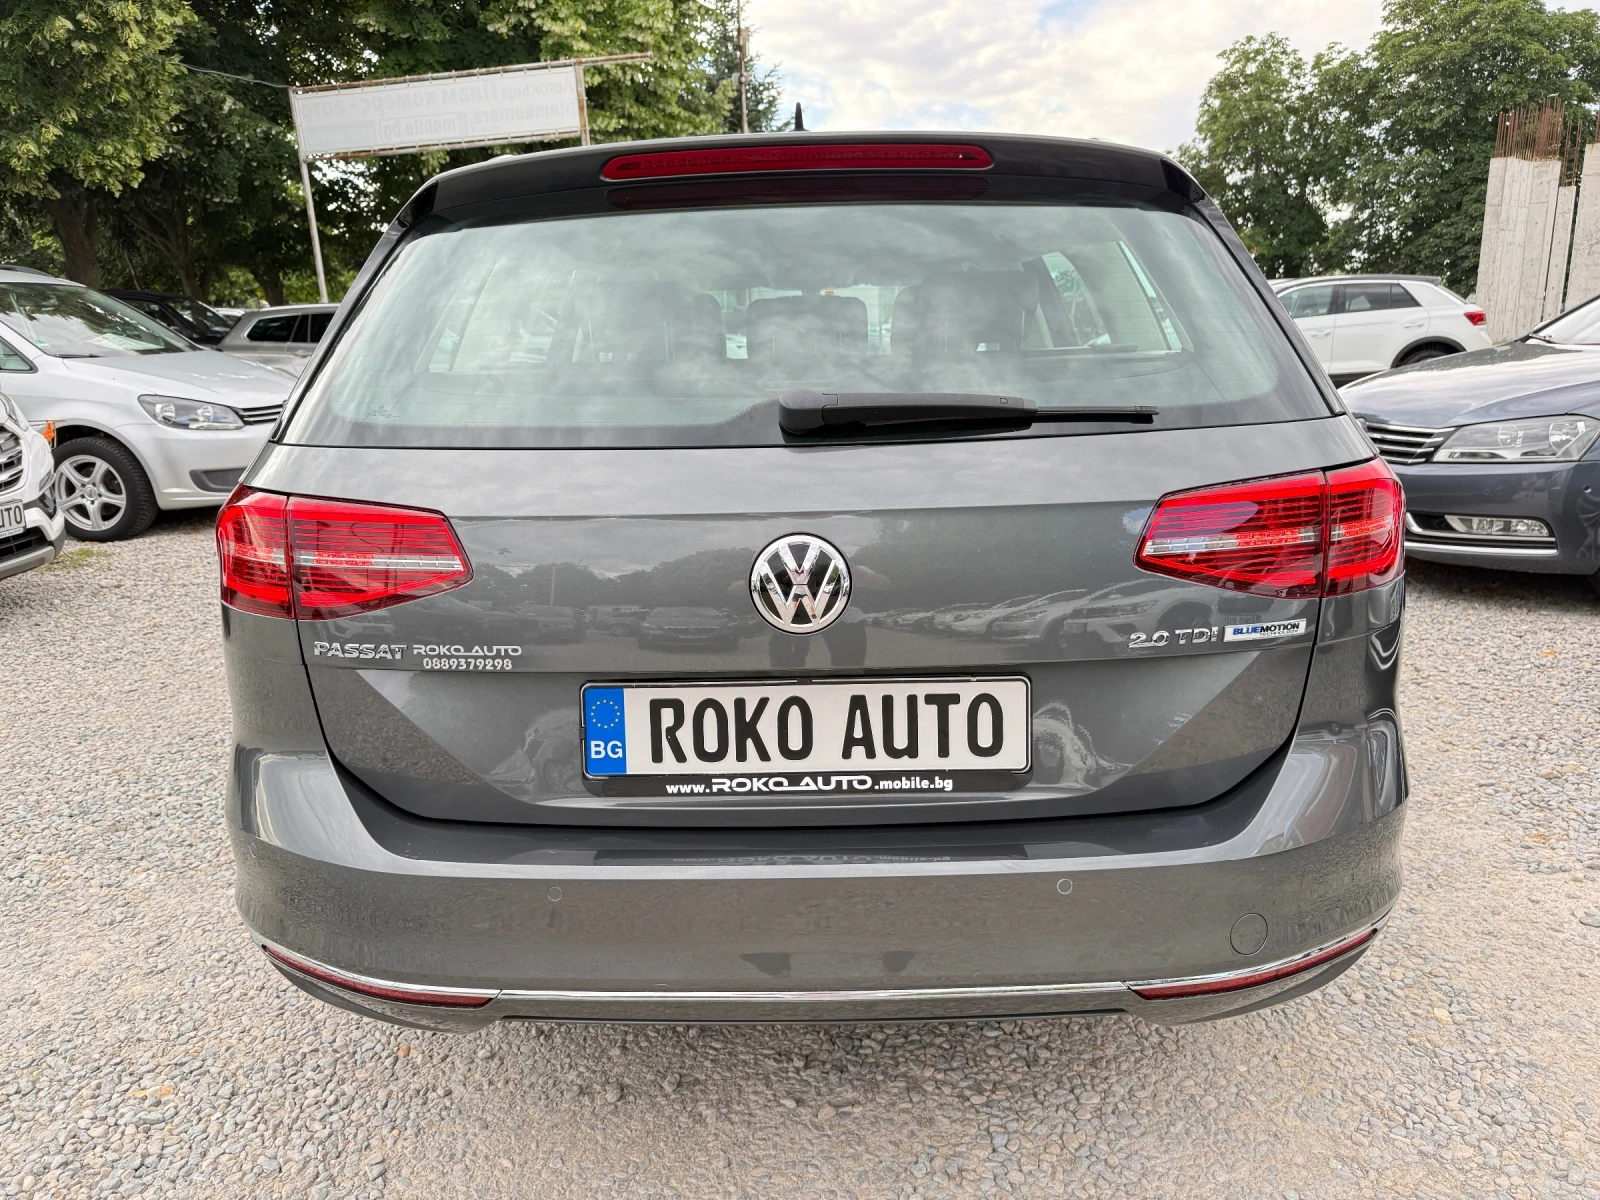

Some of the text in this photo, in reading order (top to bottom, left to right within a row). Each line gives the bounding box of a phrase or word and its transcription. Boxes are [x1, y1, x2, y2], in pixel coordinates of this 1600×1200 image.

[1174, 626, 1219, 644] TDI
[1232, 622, 1300, 635] BLUEMOTION
[313, 641, 408, 660] PASSAT
[412, 644, 523, 656] ROKO AUTO
[422, 657, 513, 670] 0889379298
[648, 692, 1005, 763] ROKO AUTO
[589, 740, 624, 759] BG
